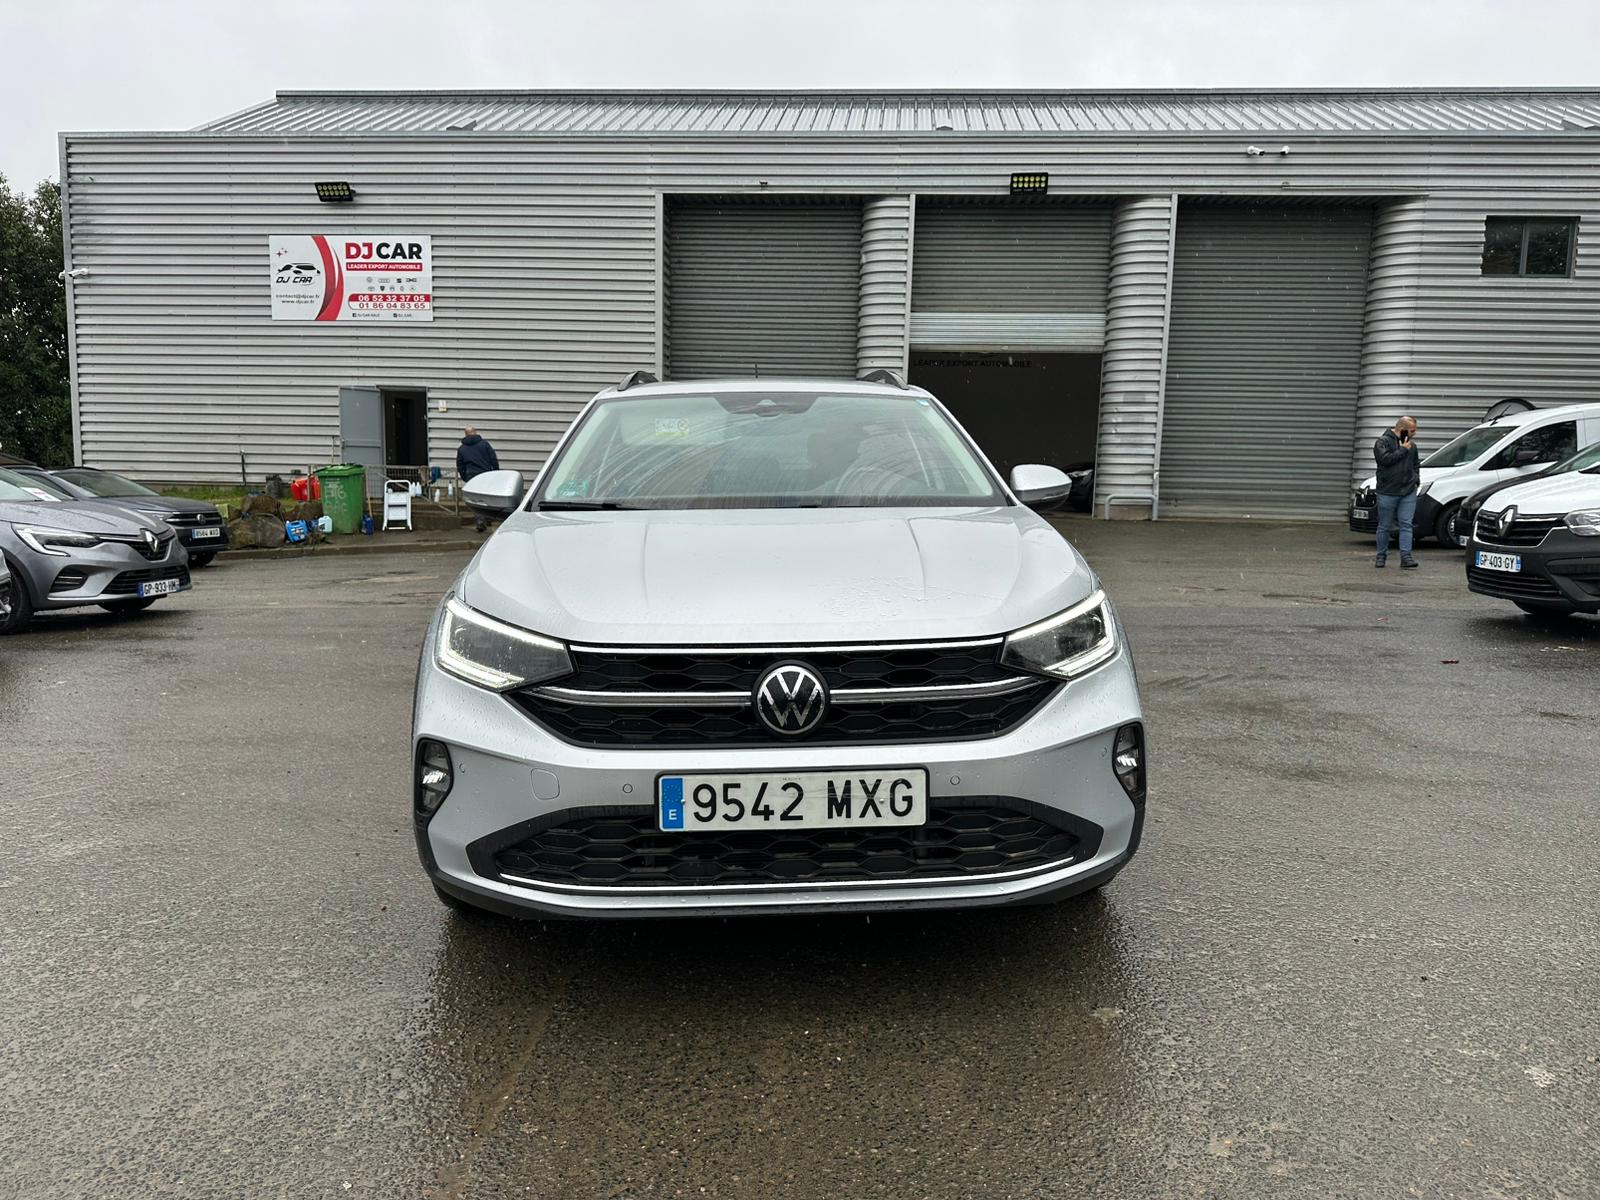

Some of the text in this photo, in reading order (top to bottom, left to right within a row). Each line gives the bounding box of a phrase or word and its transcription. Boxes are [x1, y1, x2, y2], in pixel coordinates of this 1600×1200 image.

[345, 242, 422, 260] DJ CAR
[276, 276, 313, 284] DJ CAR
[692, 778, 913, 823] 9542 MXG
[669, 809, 677, 820] E
